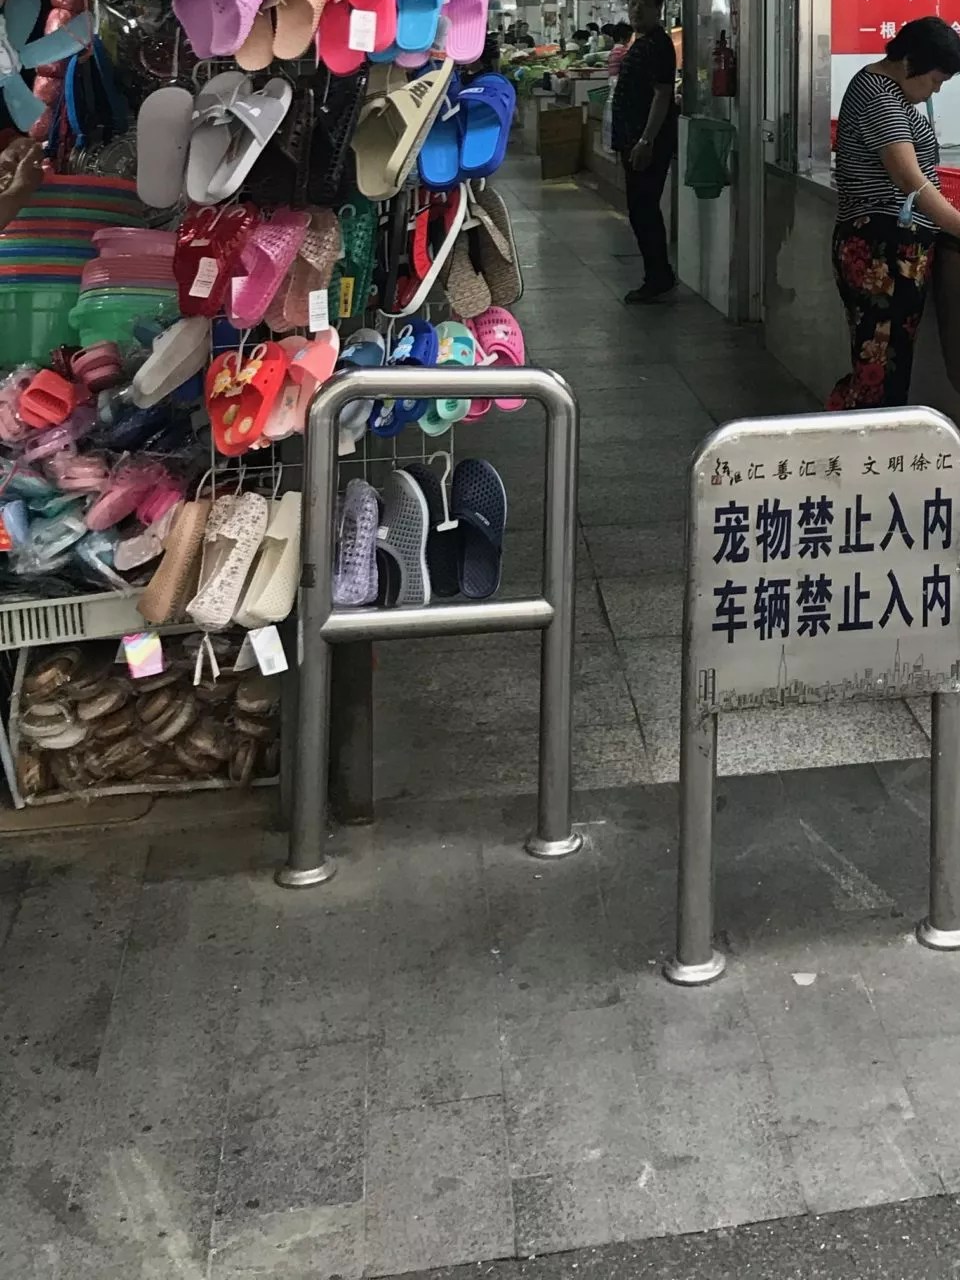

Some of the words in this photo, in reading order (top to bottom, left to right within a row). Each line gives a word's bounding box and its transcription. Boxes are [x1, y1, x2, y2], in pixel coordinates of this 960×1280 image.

[748, 455, 843, 480] 汇善汇美
[861, 453, 954, 476] 文明徐汇
[712, 487, 953, 564] 宠物禁止入内
[711, 564, 952, 643] 车辆禁止入内
